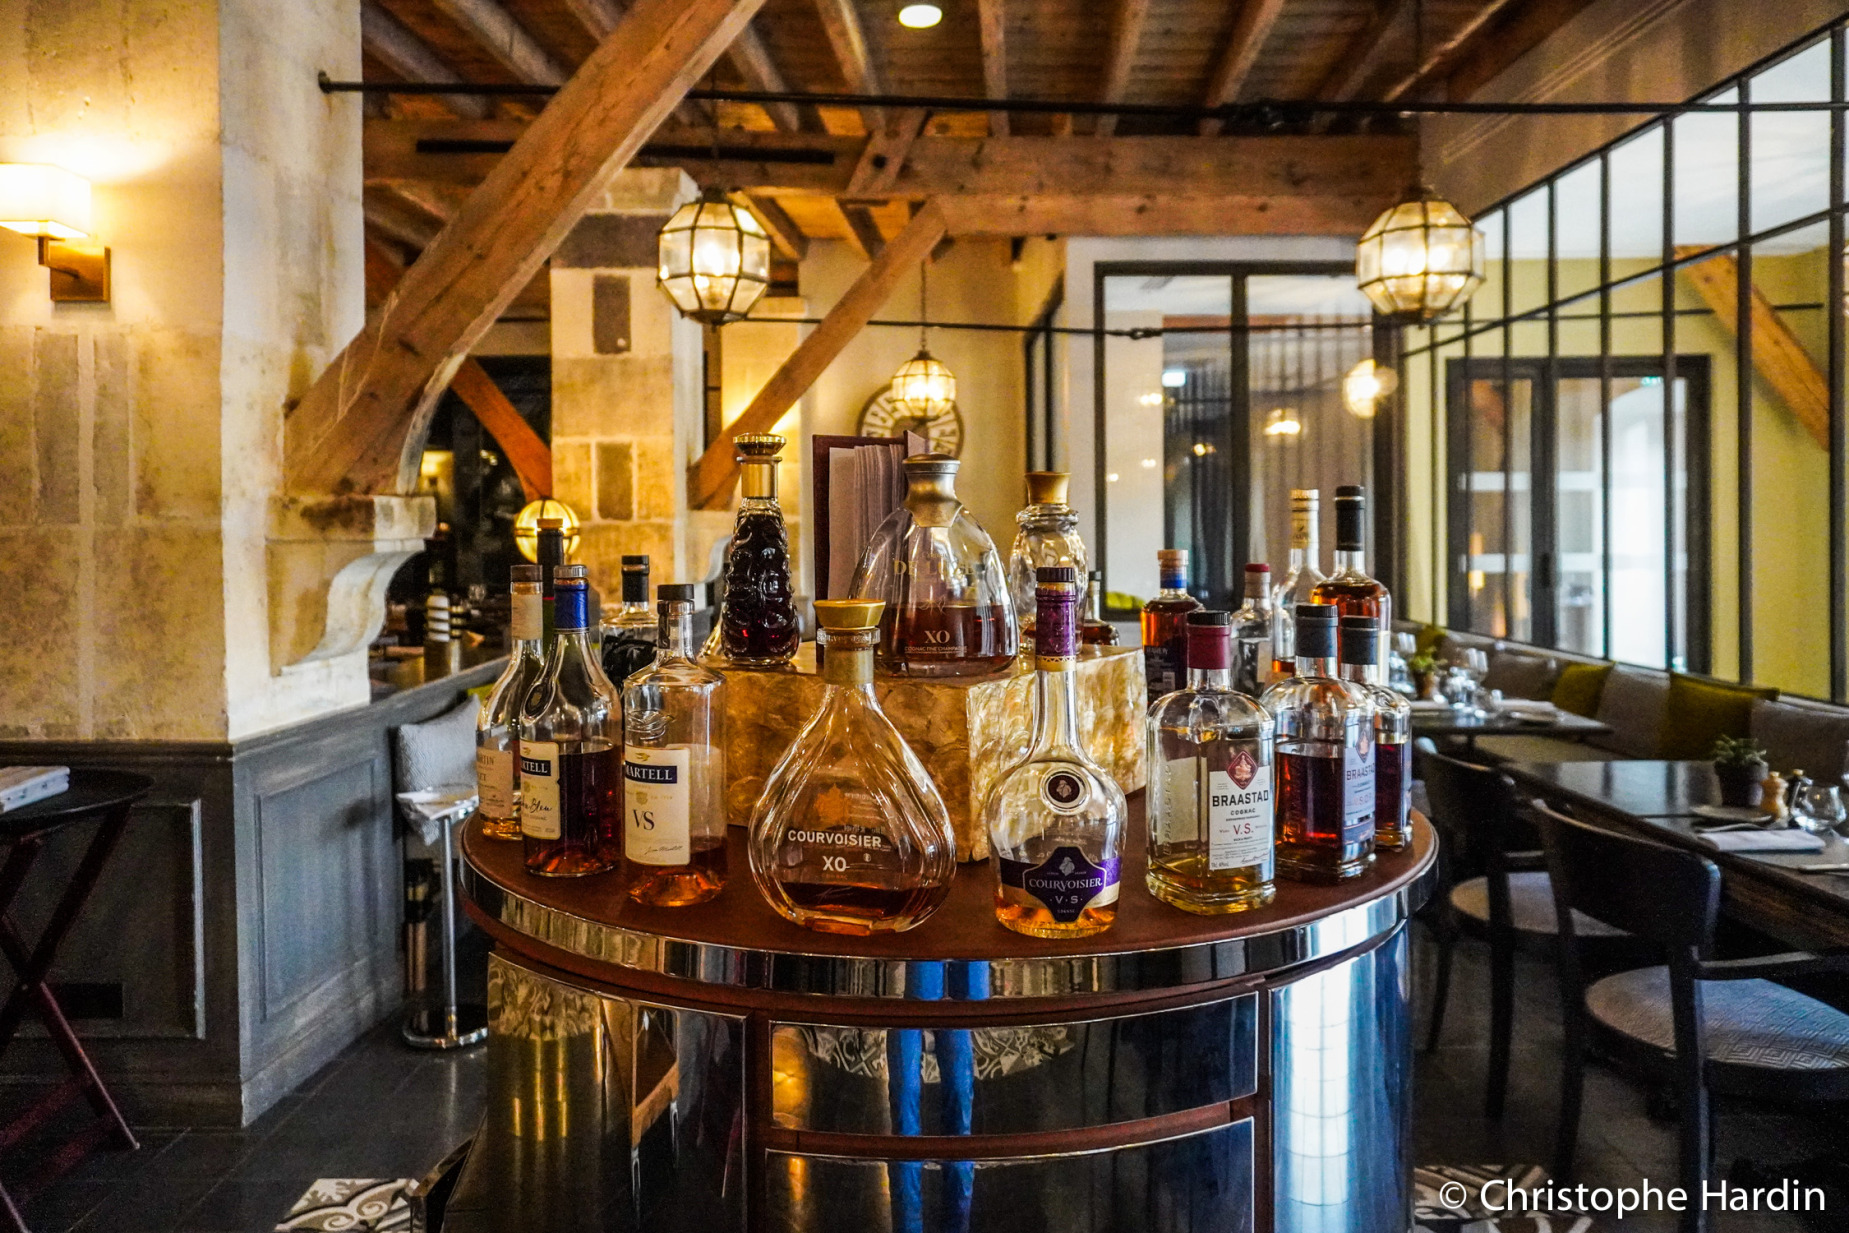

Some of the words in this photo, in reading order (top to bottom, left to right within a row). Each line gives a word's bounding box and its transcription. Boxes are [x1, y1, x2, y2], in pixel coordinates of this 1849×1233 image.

[893, 560, 918, 575] DE
[924, 630, 950, 644] XO
[1212, 789, 1269, 807] BRAASTAD
[633, 808, 655, 831] VS
[1230, 808, 1256, 816] COGNAC
[1233, 822, 1254, 835] V.S.
[788, 829, 882, 848] COURVOISIER
[822, 855, 848, 873] XO
[1029, 877, 1103, 892] COURVOISIER
